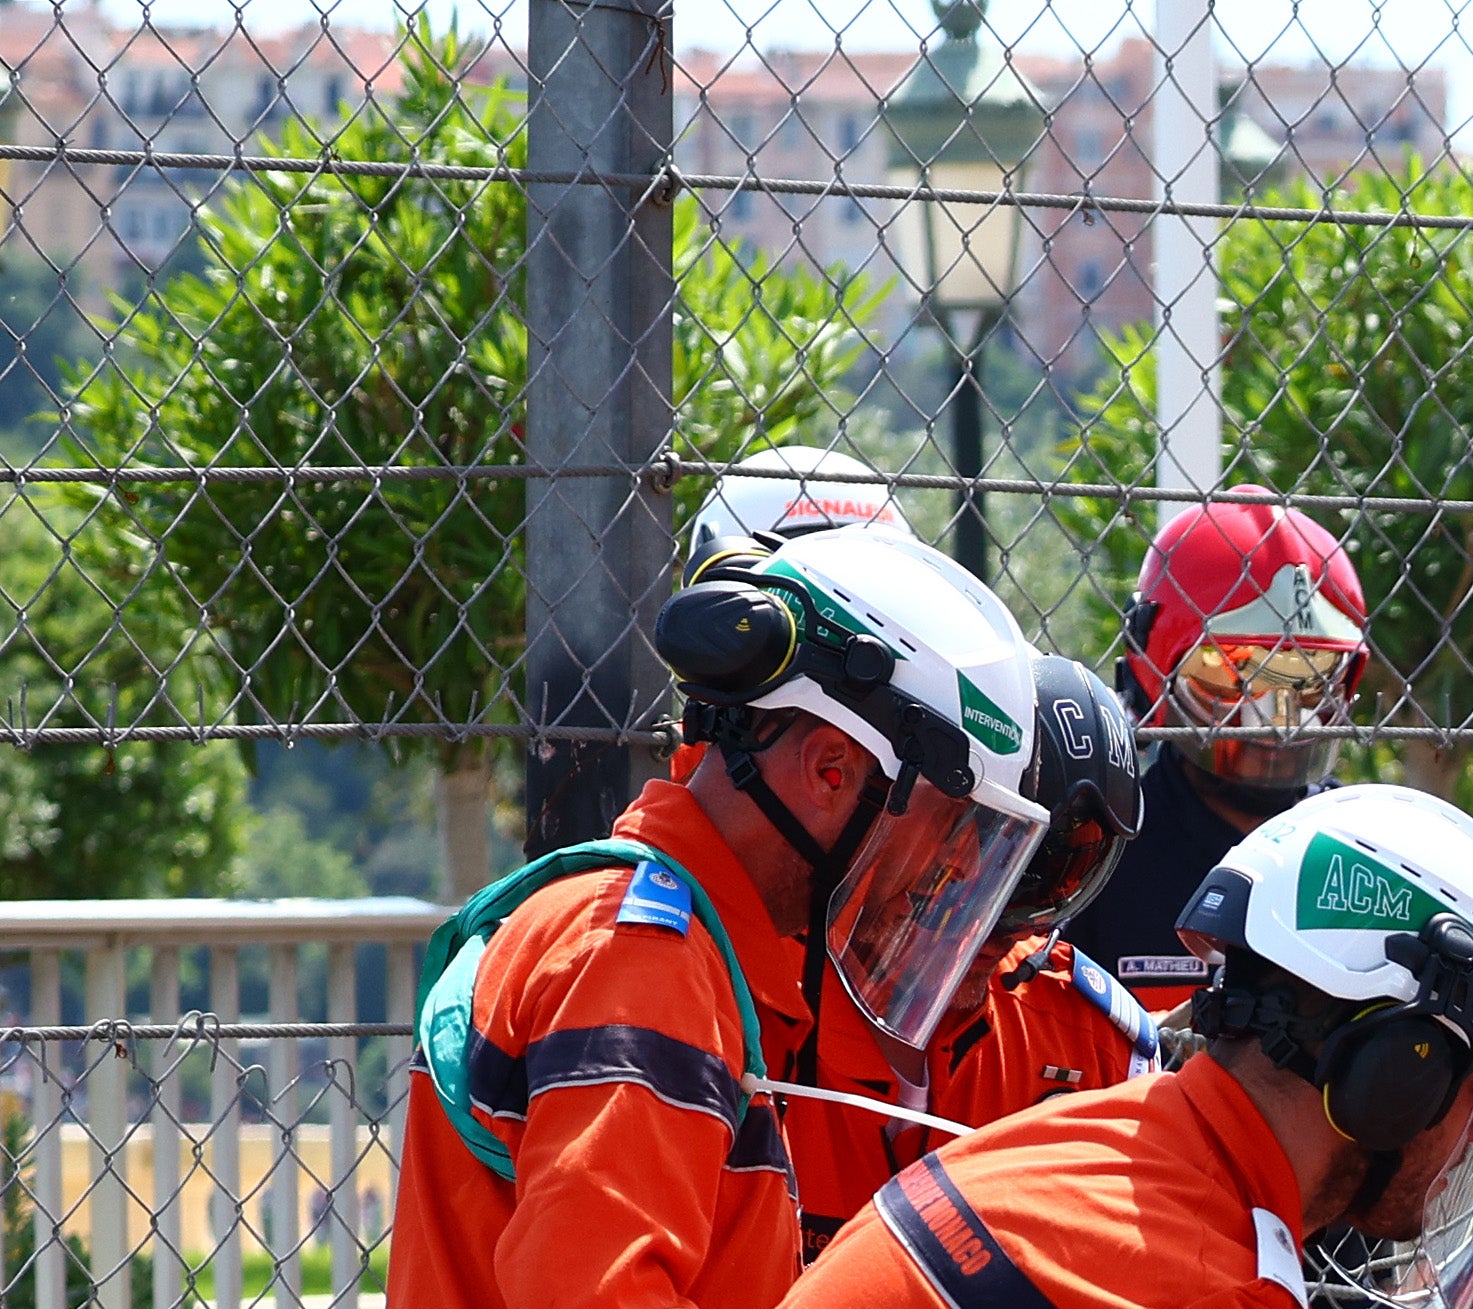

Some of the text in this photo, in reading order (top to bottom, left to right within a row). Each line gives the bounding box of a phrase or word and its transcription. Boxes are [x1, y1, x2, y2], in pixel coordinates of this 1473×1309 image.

[963, 705, 1020, 745] INTERVENTION
[1317, 854, 1414, 921] ACM
[1143, 959, 1200, 972] MATHIEU
